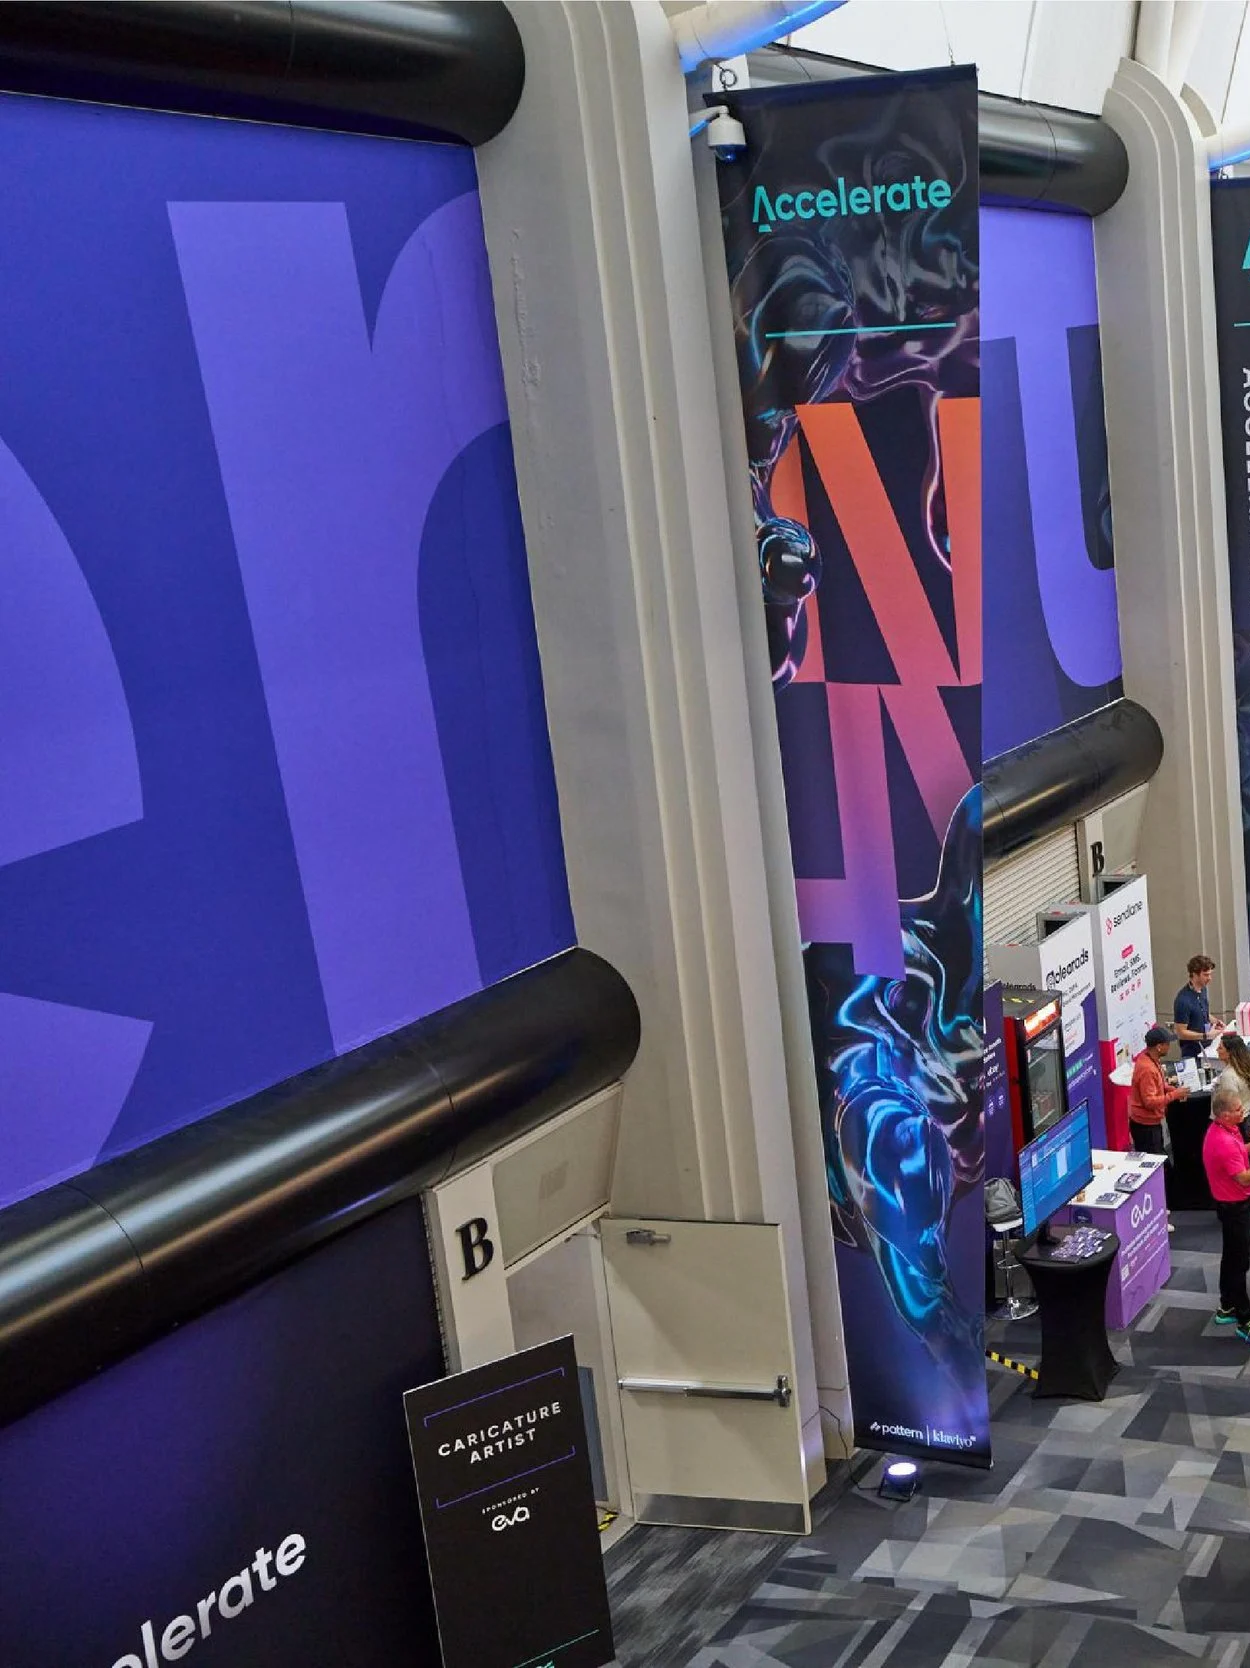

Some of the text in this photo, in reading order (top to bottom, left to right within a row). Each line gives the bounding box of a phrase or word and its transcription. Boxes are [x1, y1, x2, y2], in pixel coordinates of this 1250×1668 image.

[751, 175, 953, 234] Accelerate
[1091, 841, 1105, 877] B
[1112, 900, 1143, 928] sendlane
[456, 1216, 495, 1282] B
[437, 1401, 562, 1456] CARICATURE
[470, 1427, 536, 1465] ARTIST
[881, 1424, 974, 1450] pattern klaviyo
